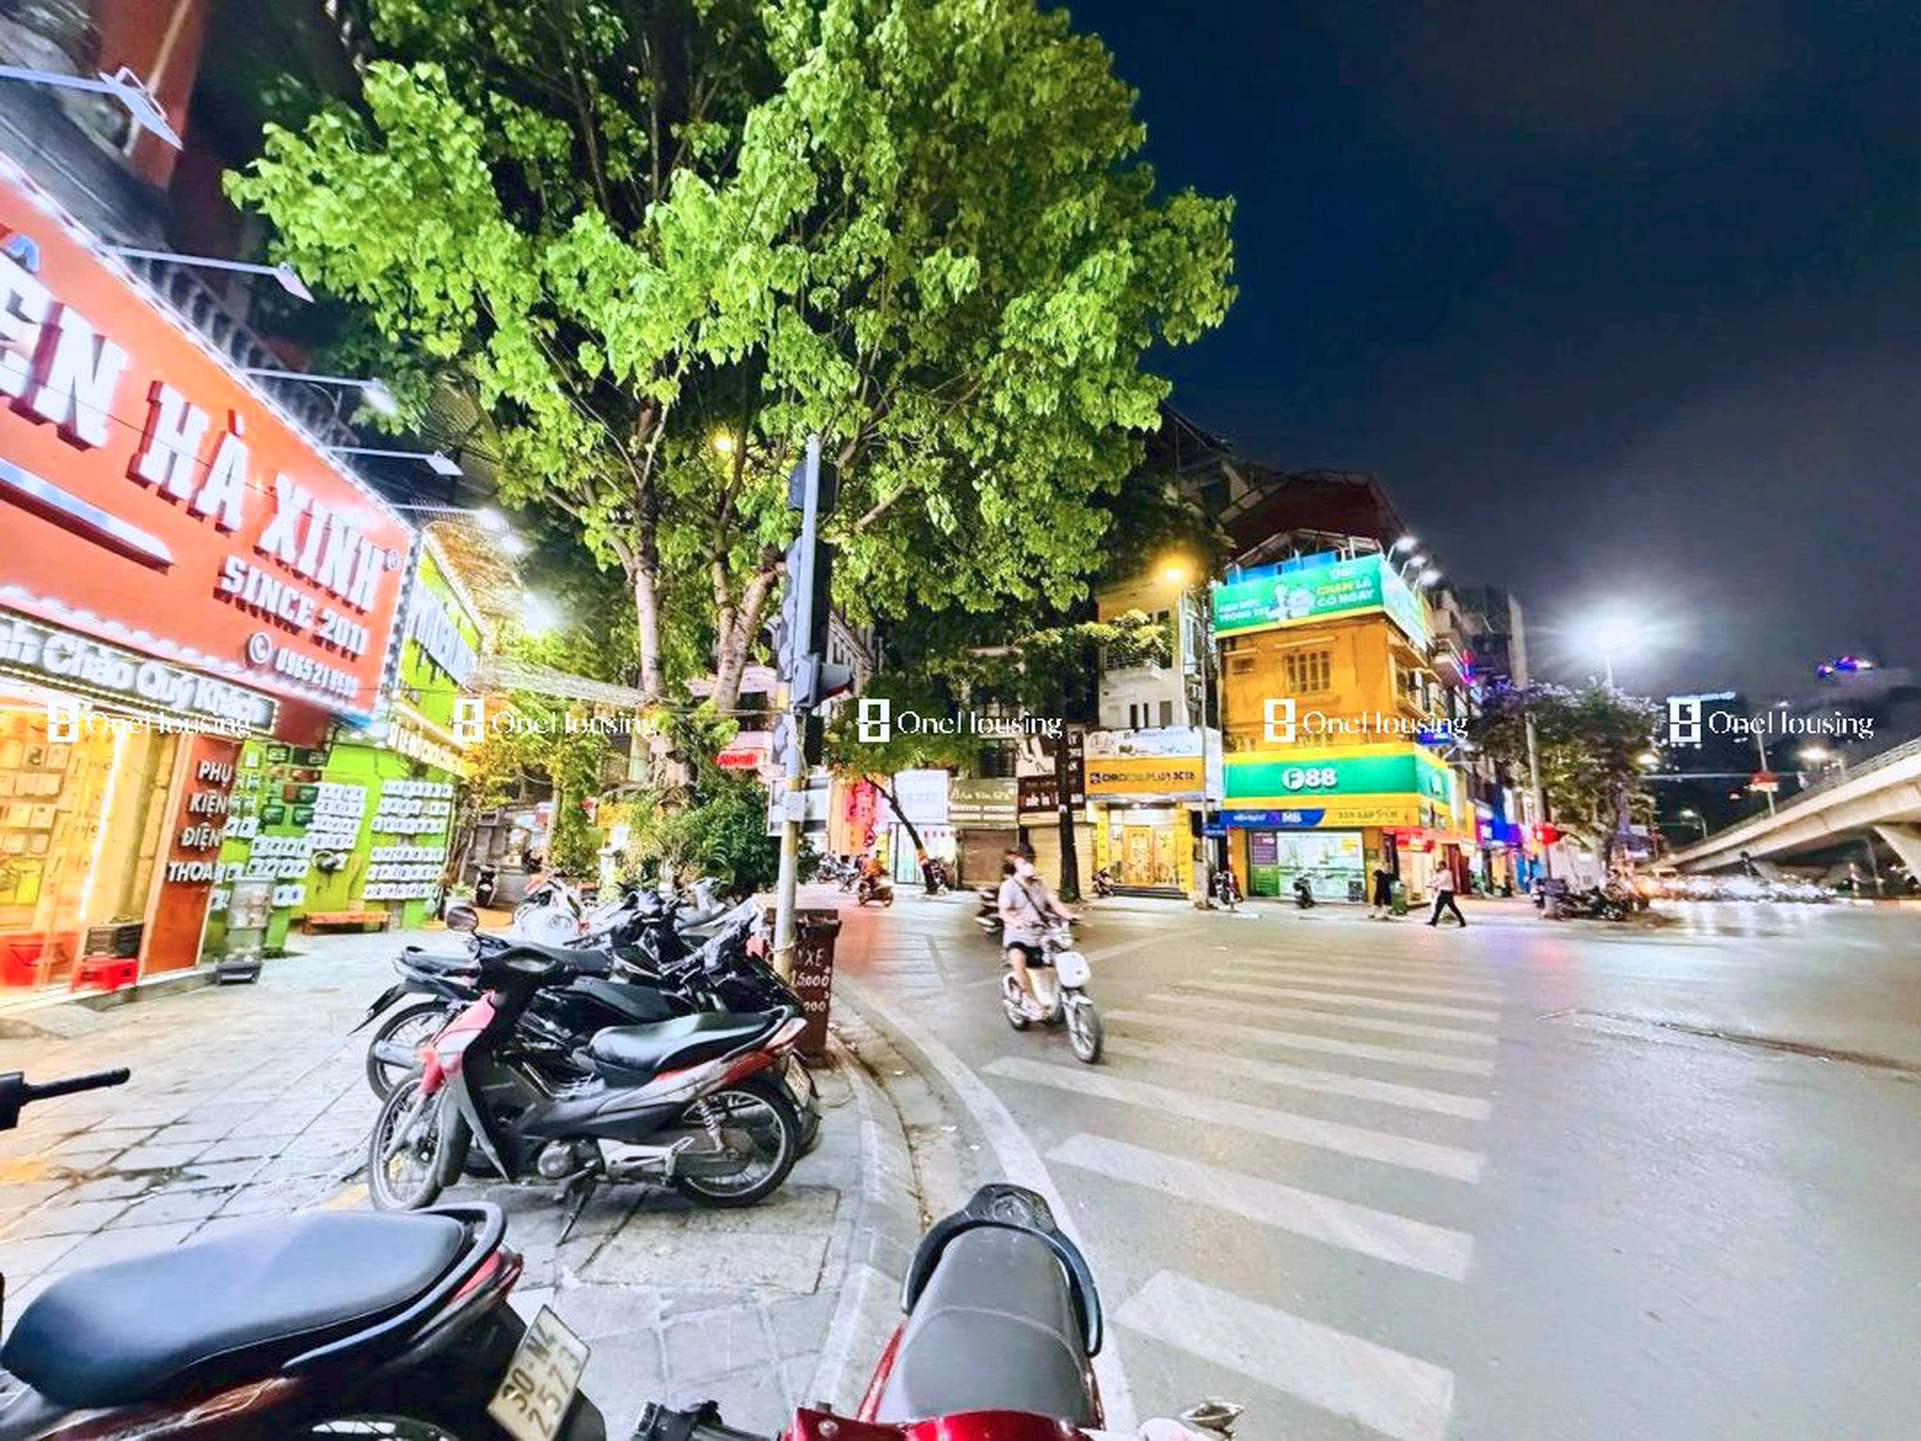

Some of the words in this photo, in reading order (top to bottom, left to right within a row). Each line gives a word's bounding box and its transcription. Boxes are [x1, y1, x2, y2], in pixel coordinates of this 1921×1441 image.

[129, 380, 249, 534] HÀ
[255, 471, 388, 614] XINH
[216, 554, 316, 632] SINCE
[317, 607, 370, 656] 2011
[198, 761, 233, 787] PHỤ
[1281, 767, 1339, 791] F88
[188, 789, 228, 817] KIỆN
[180, 822, 221, 851] ĐIỆN
